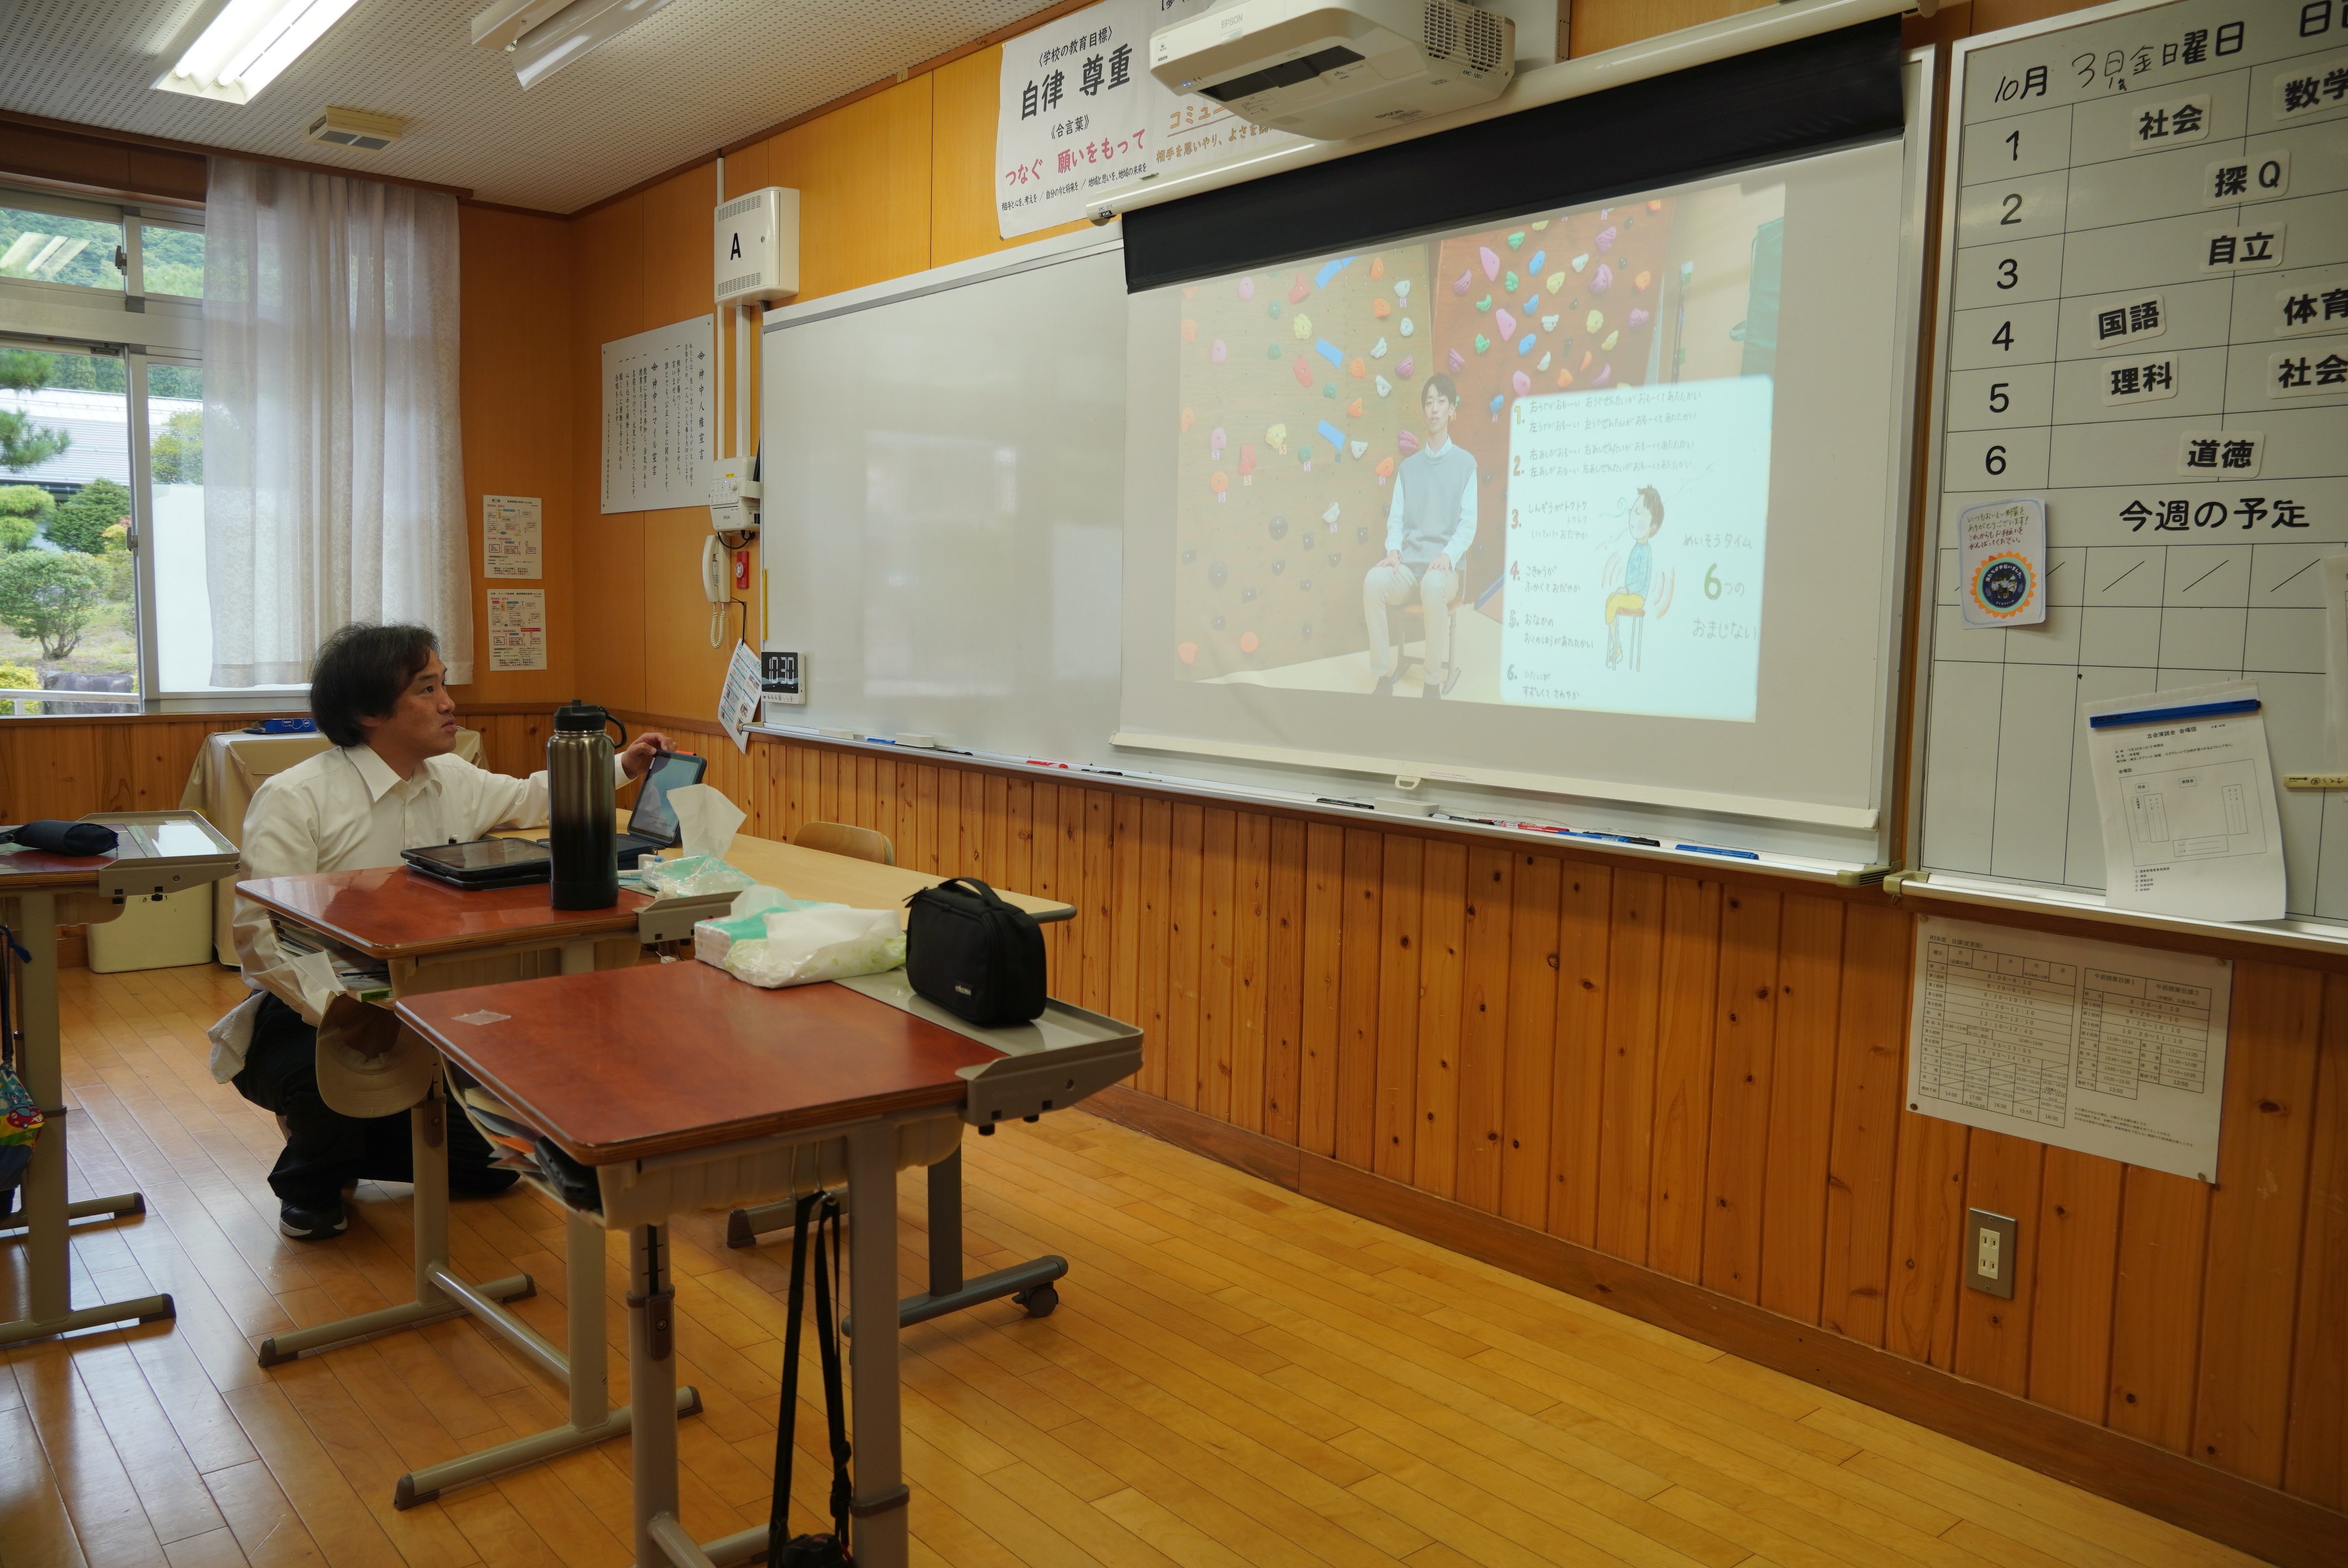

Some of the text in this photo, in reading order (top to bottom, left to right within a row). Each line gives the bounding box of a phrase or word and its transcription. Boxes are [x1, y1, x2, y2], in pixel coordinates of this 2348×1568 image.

[1221, 14, 1243, 28] EPSON
[2299, 0, 2348, 38] 日
[1022, 43, 1132, 120] 自律 尊重
[1462, 69, 1483, 79] KMC-1001
[2284, 67, 2348, 112] 数学
[1375, 110, 1403, 120] EPSON
[2138, 104, 2203, 141] 社会
[1006, 128, 1145, 185] つなぐ 願いをもって
[2005, 130, 2020, 161] 1
[1002, 194, 1037, 211] 相手と心を、考えを
[1046, 181, 1078, 199] 自分の今と将来を
[2001, 194, 2022, 225] 2
[730, 233, 742, 261] A
[2209, 231, 2273, 266] 自立
[1996, 259, 2019, 290] 3
[2099, 300, 2160, 340] 国語
[2283, 288, 2348, 326] 体育
[1992, 321, 2015, 352] 4
[2110, 362, 2172, 396] 理科
[2278, 354, 2348, 388] 社会
[1989, 383, 2010, 413] 5
[1985, 445, 2006, 476] 6
[2188, 439, 2255, 468] 道徳
[1967, 506, 2025, 523] いつもおいしい野菜を
[2119, 498, 2310, 533] 今週の予定
[1525, 613, 1554, 627] おなかの
[1692, 617, 1757, 640] おまじない
[2147, 726, 2197, 739] 立会演説会 会場図
